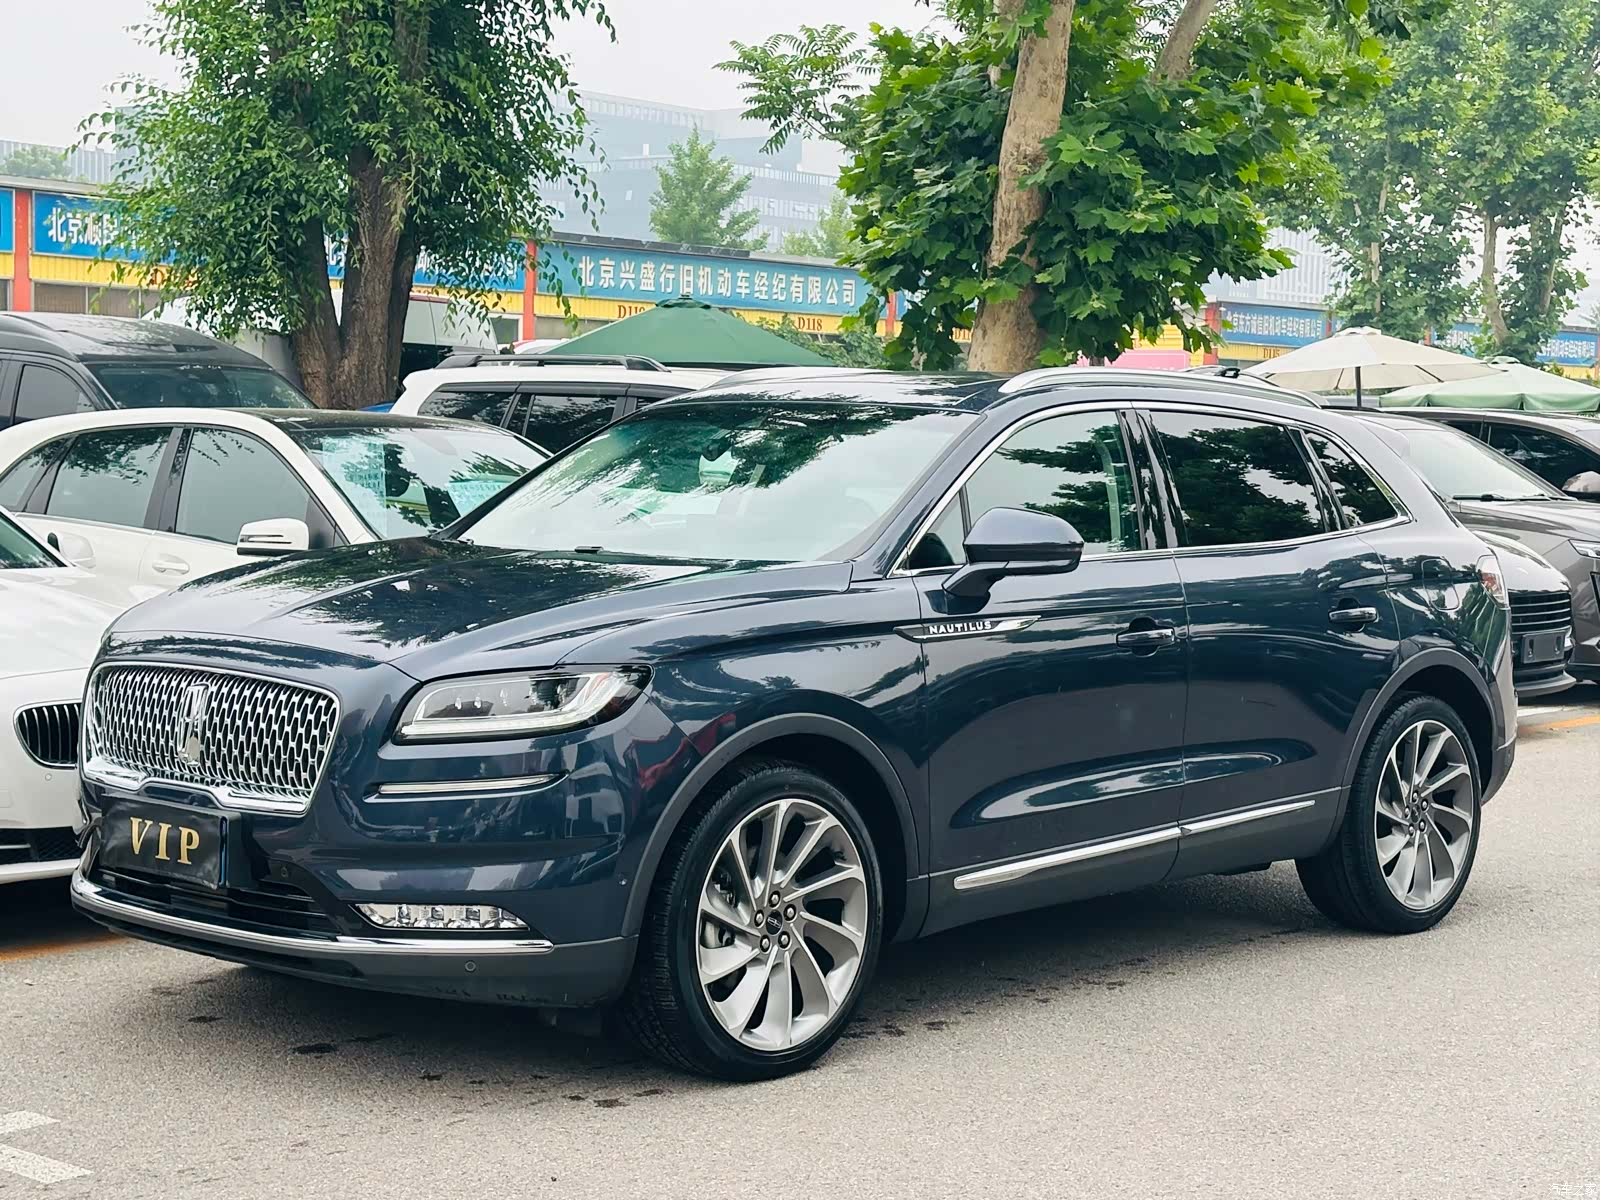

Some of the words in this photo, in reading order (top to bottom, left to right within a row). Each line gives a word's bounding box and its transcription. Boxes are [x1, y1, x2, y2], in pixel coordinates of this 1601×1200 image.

[578, 255, 857, 306] 北京兴盛行旧机动车经纪有限公司
[798, 316, 823, 331] D118
[929, 620, 992, 635] NAUTILUS
[130, 817, 200, 865] VIP
